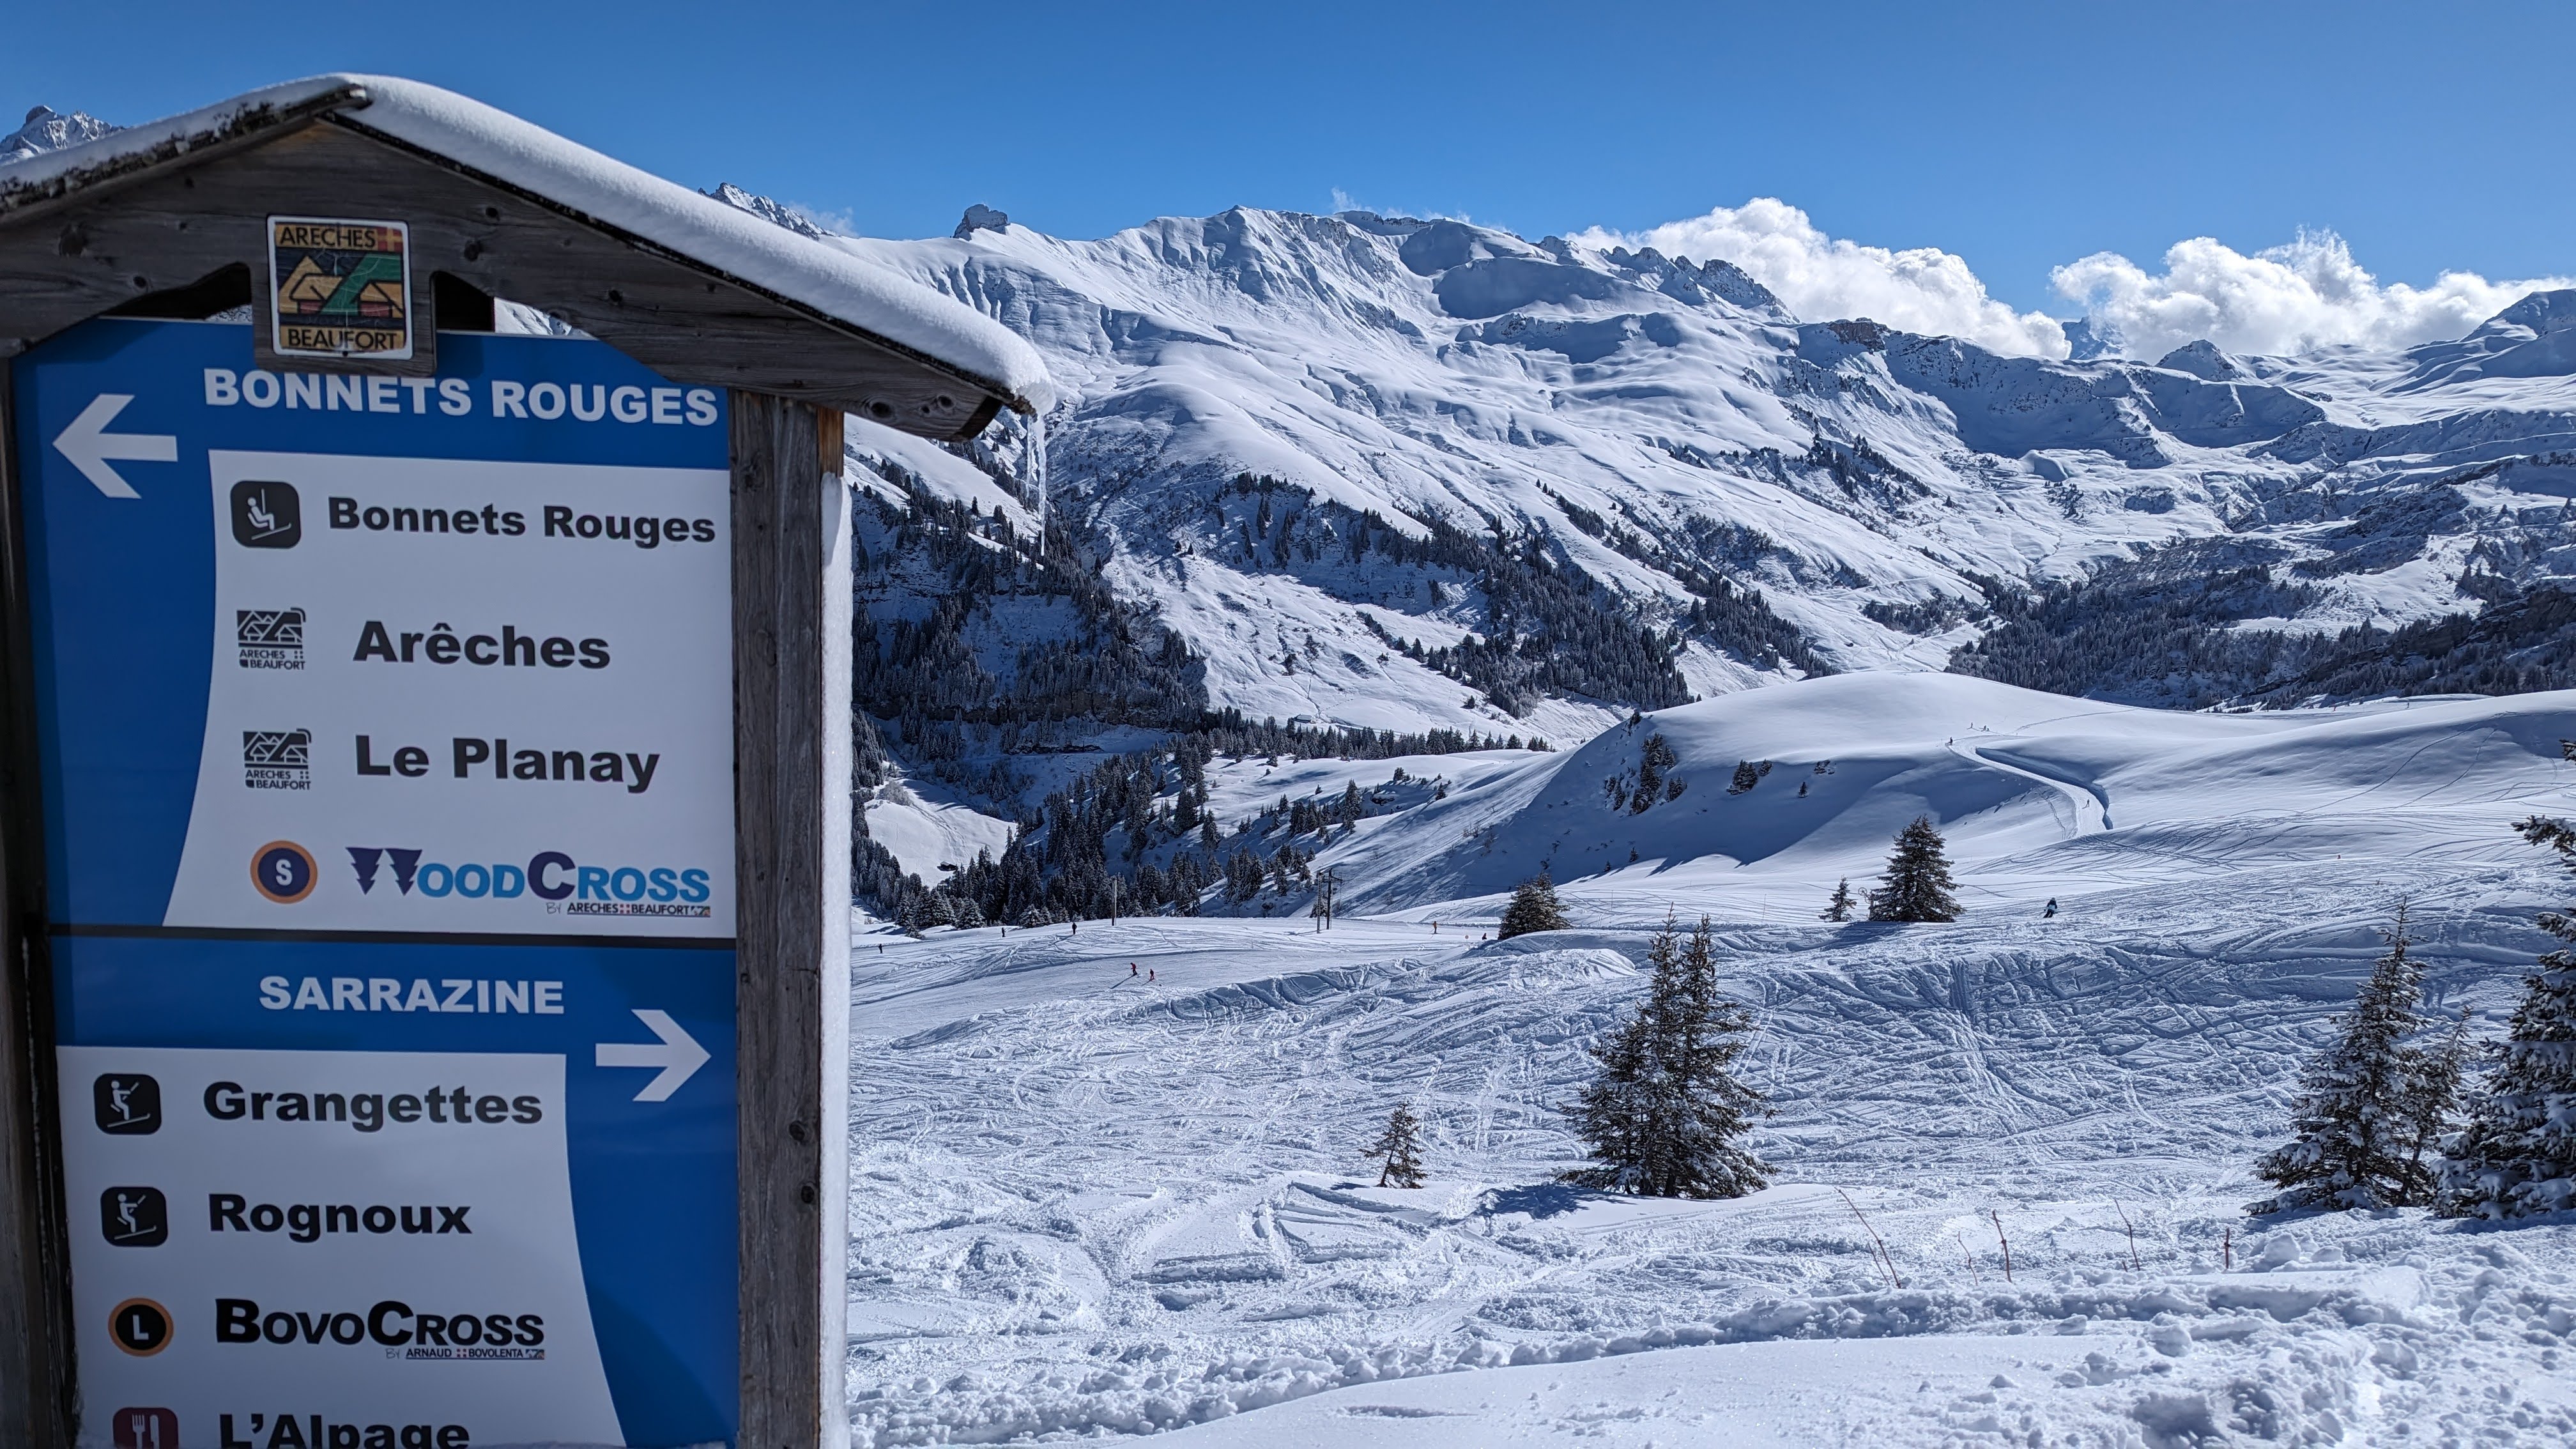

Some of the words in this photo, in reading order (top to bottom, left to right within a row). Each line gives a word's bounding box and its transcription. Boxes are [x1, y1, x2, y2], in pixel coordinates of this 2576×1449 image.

[280, 226, 376, 248] ARECHES
[288, 328, 397, 349] BEAUFORT
[204, 368, 471, 416] BONNETS
[491, 380, 717, 426] ROUGES
[328, 496, 526, 536] Bonnets
[543, 505, 716, 549] Rouges
[239, 648, 286, 659] ARECHES
[353, 620, 610, 670] Arêches
[249, 659, 306, 670] BEAUFORT
[245, 769, 291, 780] ARECHES
[355, 735, 429, 778] Le
[452, 737, 660, 793] Planay
[256, 779, 311, 790] BEAUFORT
[275, 859, 293, 886] S
[567, 902, 619, 914] ARECHES
[631, 903, 689, 915] BEAUFORT
[259, 976, 564, 1014] SARRAZINE
[203, 1081, 542, 1133] Grangettes
[208, 1193, 472, 1243] Rognoux
[132, 1314, 150, 1340] L
[406, 1348, 452, 1358] ARNAUD
[468, 1348, 524, 1358] BOVOLENTA
